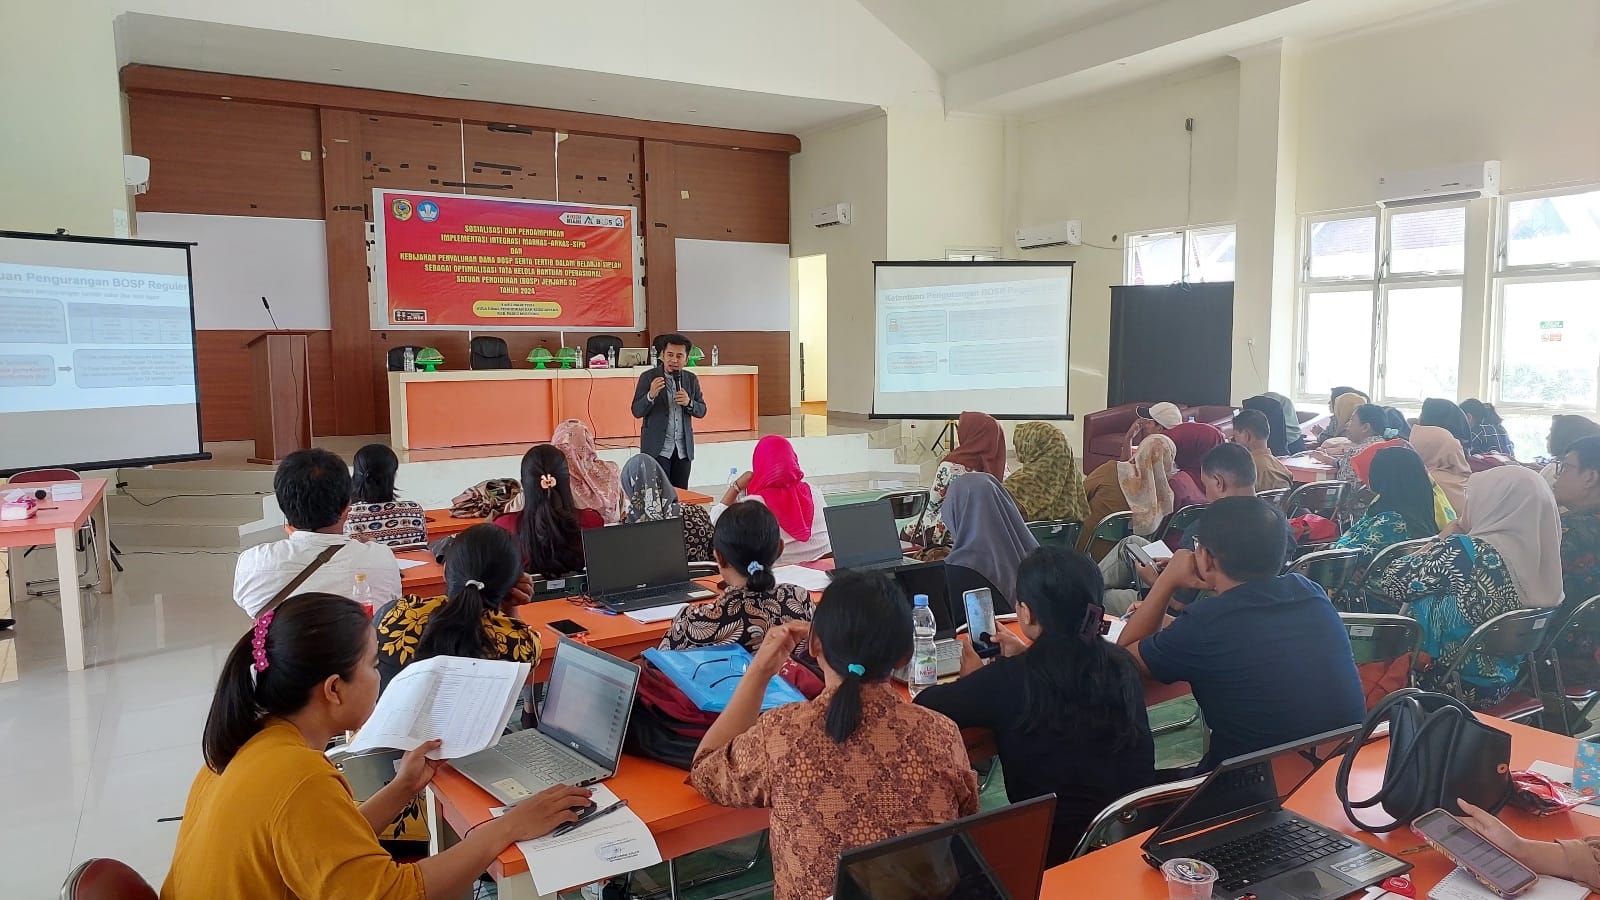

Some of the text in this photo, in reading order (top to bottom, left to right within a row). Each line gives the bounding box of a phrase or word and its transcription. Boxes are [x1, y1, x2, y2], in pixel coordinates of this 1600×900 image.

[464, 225, 503, 234] SOSIALISASI
[518, 228, 565, 237] PENDAMPINGAN
[440, 234, 488, 243] IMPLEMENTASI
[490, 236, 521, 245] INTEGRASI
[24, 272, 109, 287] Pengurangan
[112, 278, 145, 289] BOSP
